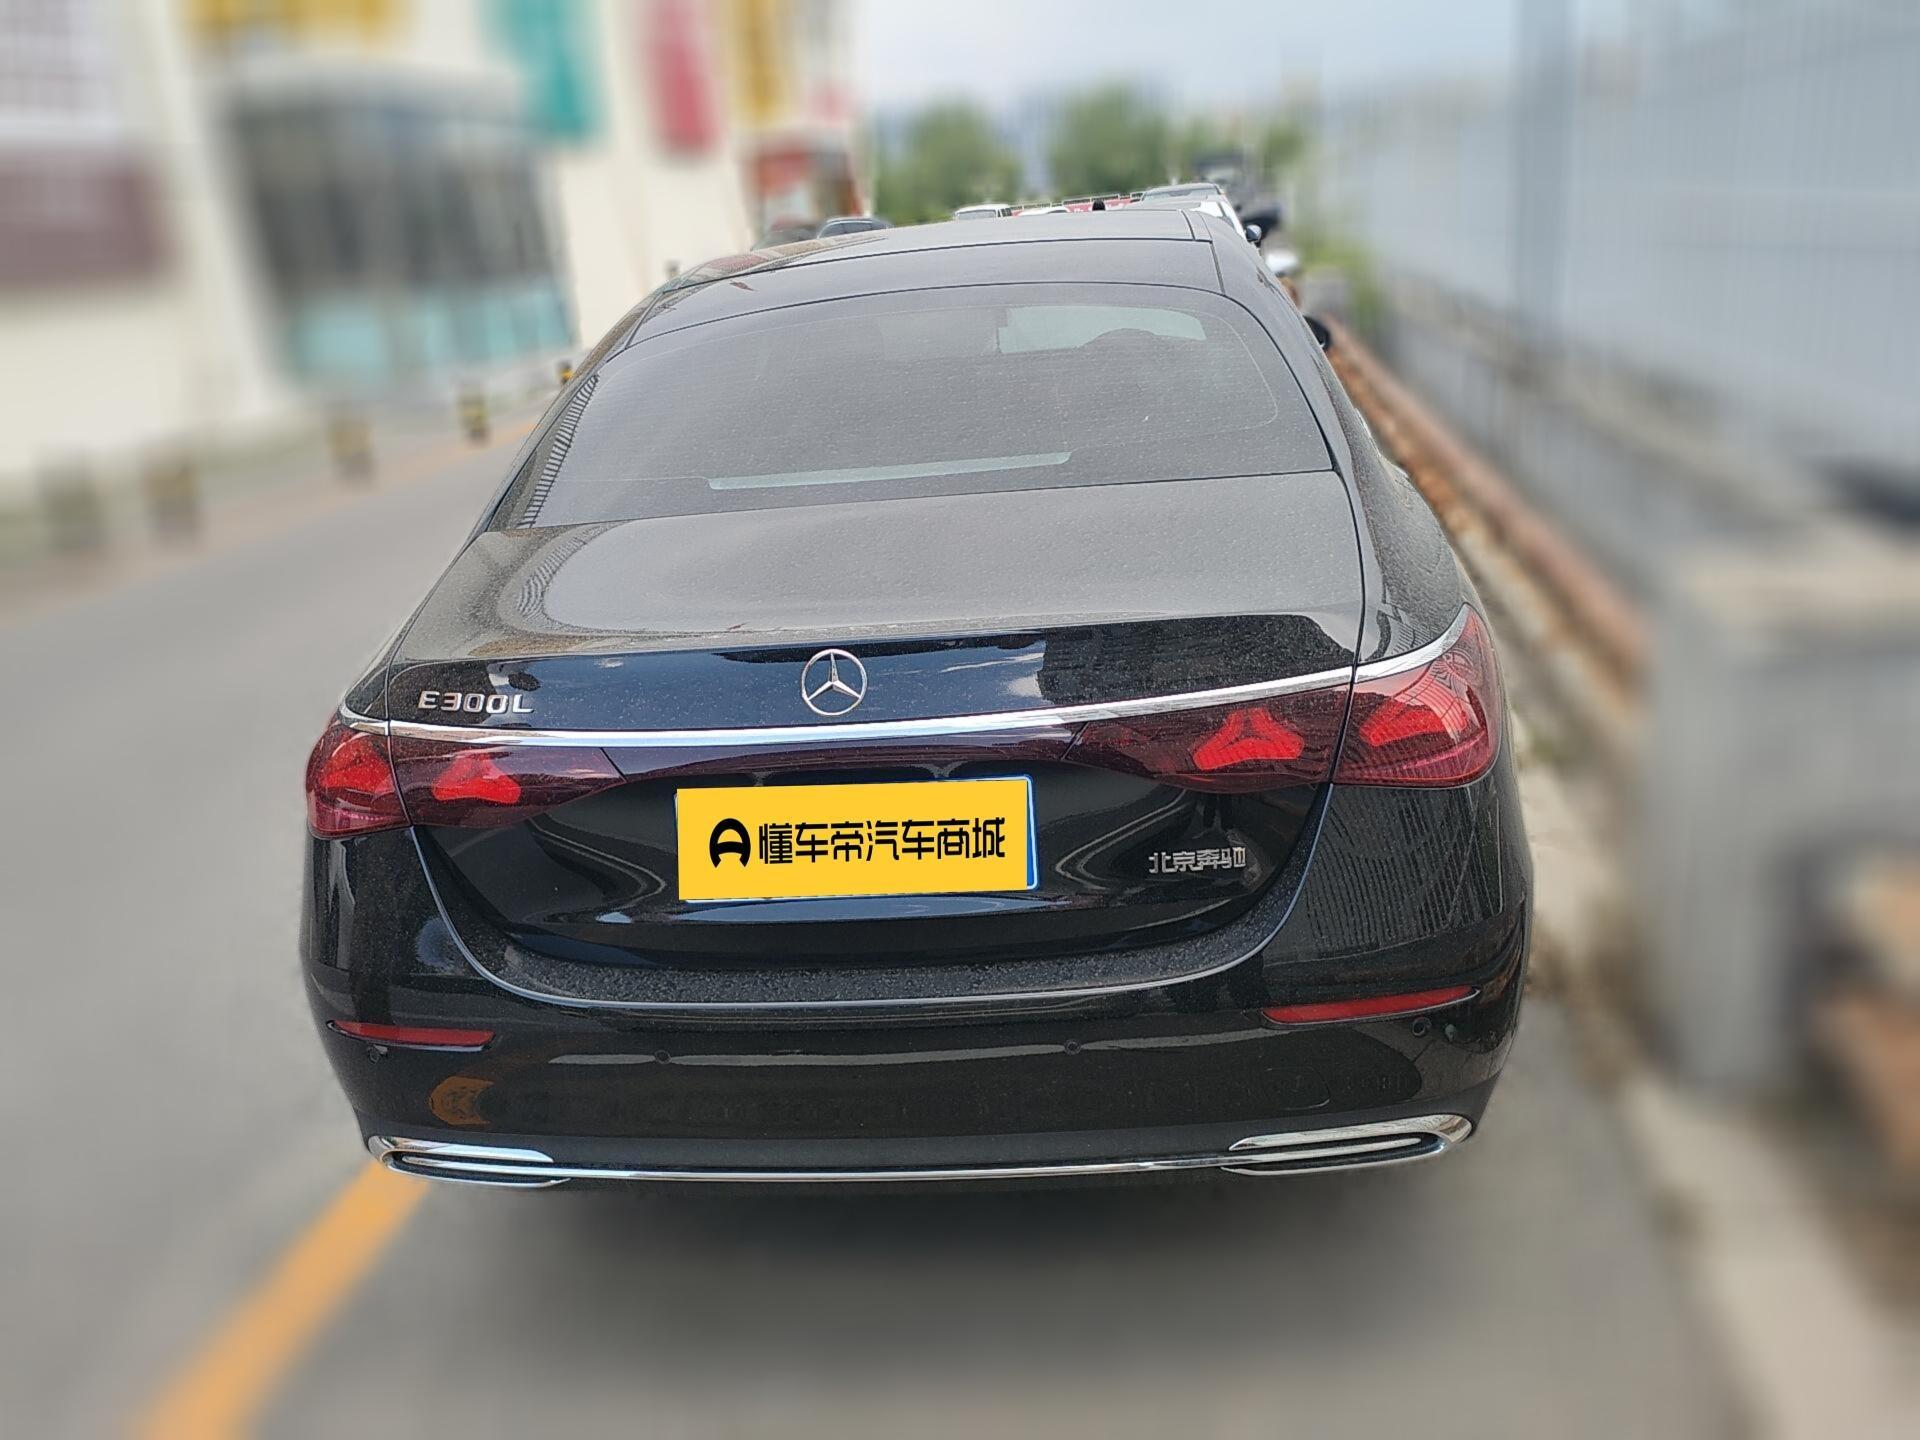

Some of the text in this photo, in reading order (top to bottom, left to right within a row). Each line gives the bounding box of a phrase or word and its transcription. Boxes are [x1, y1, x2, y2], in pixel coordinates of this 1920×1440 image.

[418, 690, 535, 714] E300L
[1148, 846, 1246, 874] 北京奔驰
